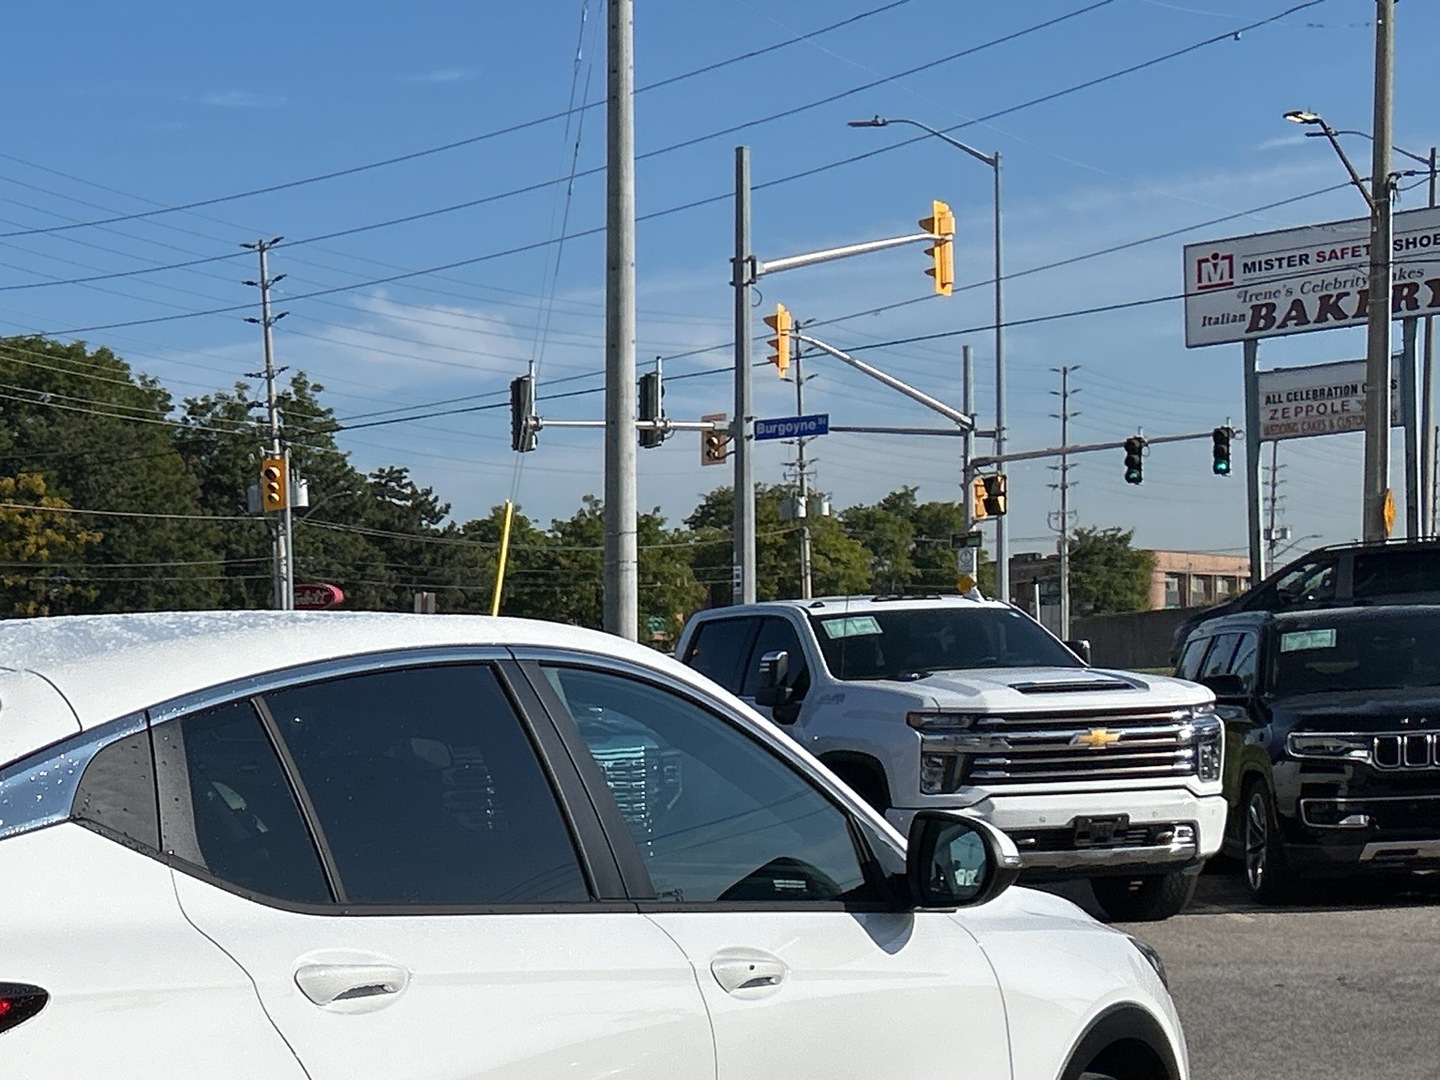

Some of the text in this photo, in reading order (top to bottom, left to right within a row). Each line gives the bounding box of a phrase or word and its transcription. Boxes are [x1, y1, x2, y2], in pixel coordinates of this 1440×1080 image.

[1242, 253, 1310, 274] MISTER
[1316, 244, 1371, 263] SAFET
[1237, 284, 1293, 303] Irene's
[1393, 267, 1424, 281] kes
[1202, 312, 1246, 327] Italian
[1265, 393, 1283, 405] ALL
[1286, 383, 1358, 402] CELEBRATION
[1270, 400, 1351, 420] ZEPPOLE
[756, 420, 816, 436] Burgoyne
